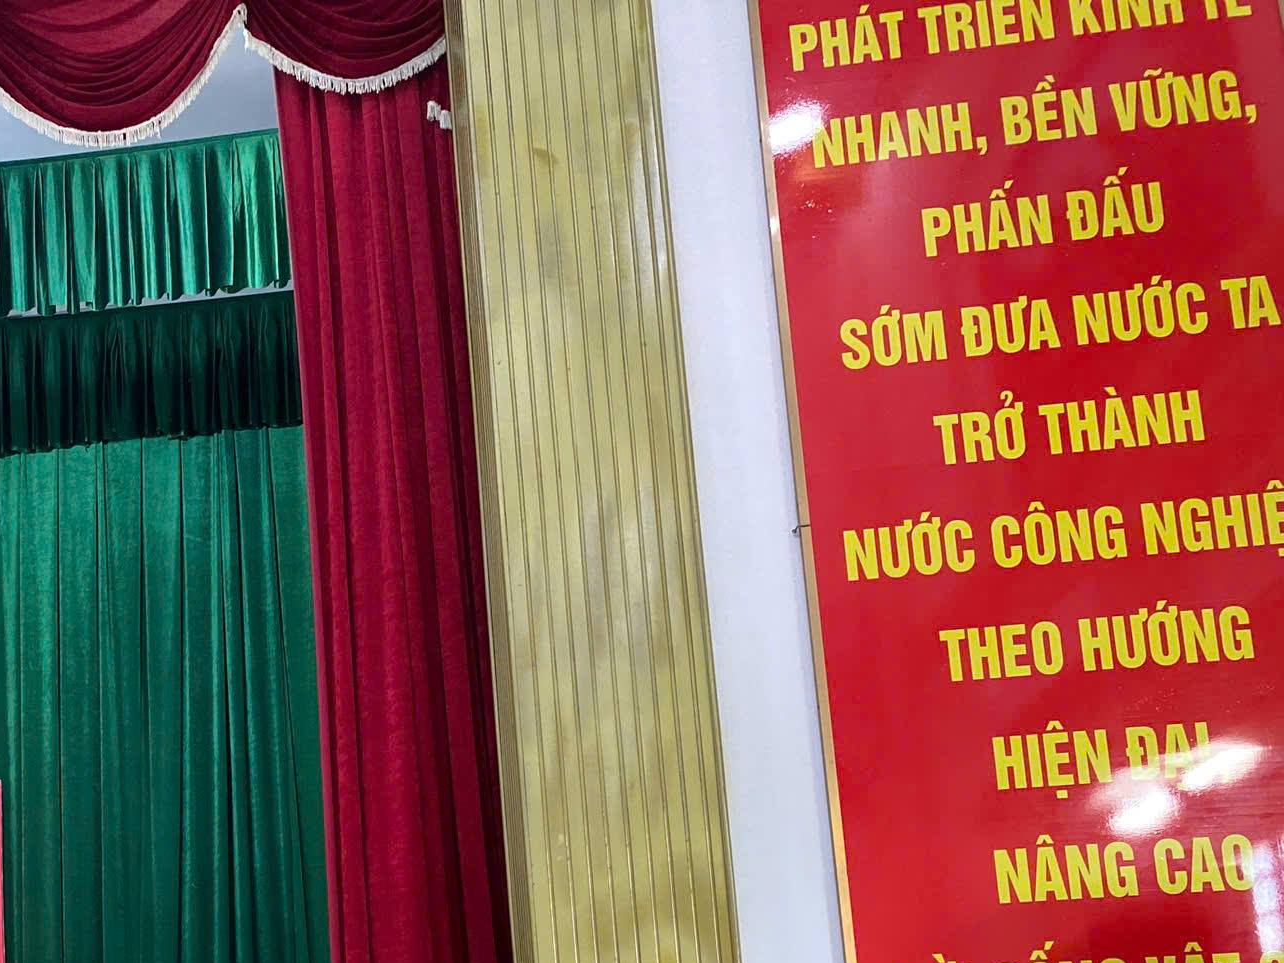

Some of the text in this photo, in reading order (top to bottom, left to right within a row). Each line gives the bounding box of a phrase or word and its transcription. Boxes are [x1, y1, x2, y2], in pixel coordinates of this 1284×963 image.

[788, 4, 904, 72] PHÁT
[811, 68, 1257, 169] NHANH, BỀN VỮNG,
[921, 166, 1165, 258] PHẤN ĐẤU
[839, 275, 1282, 370] SỚM ĐƯA NƯỚC TA
[932, 386, 1205, 465] TRỞ THÀNH
[843, 511, 976, 582] NƯỚC
[990, 501, 1128, 569] CÔNG
[939, 600, 1255, 682] THEO HƯỚNG
[992, 720, 1113, 799] HIỆN
[993, 834, 1253, 904] NÂNG CAO
